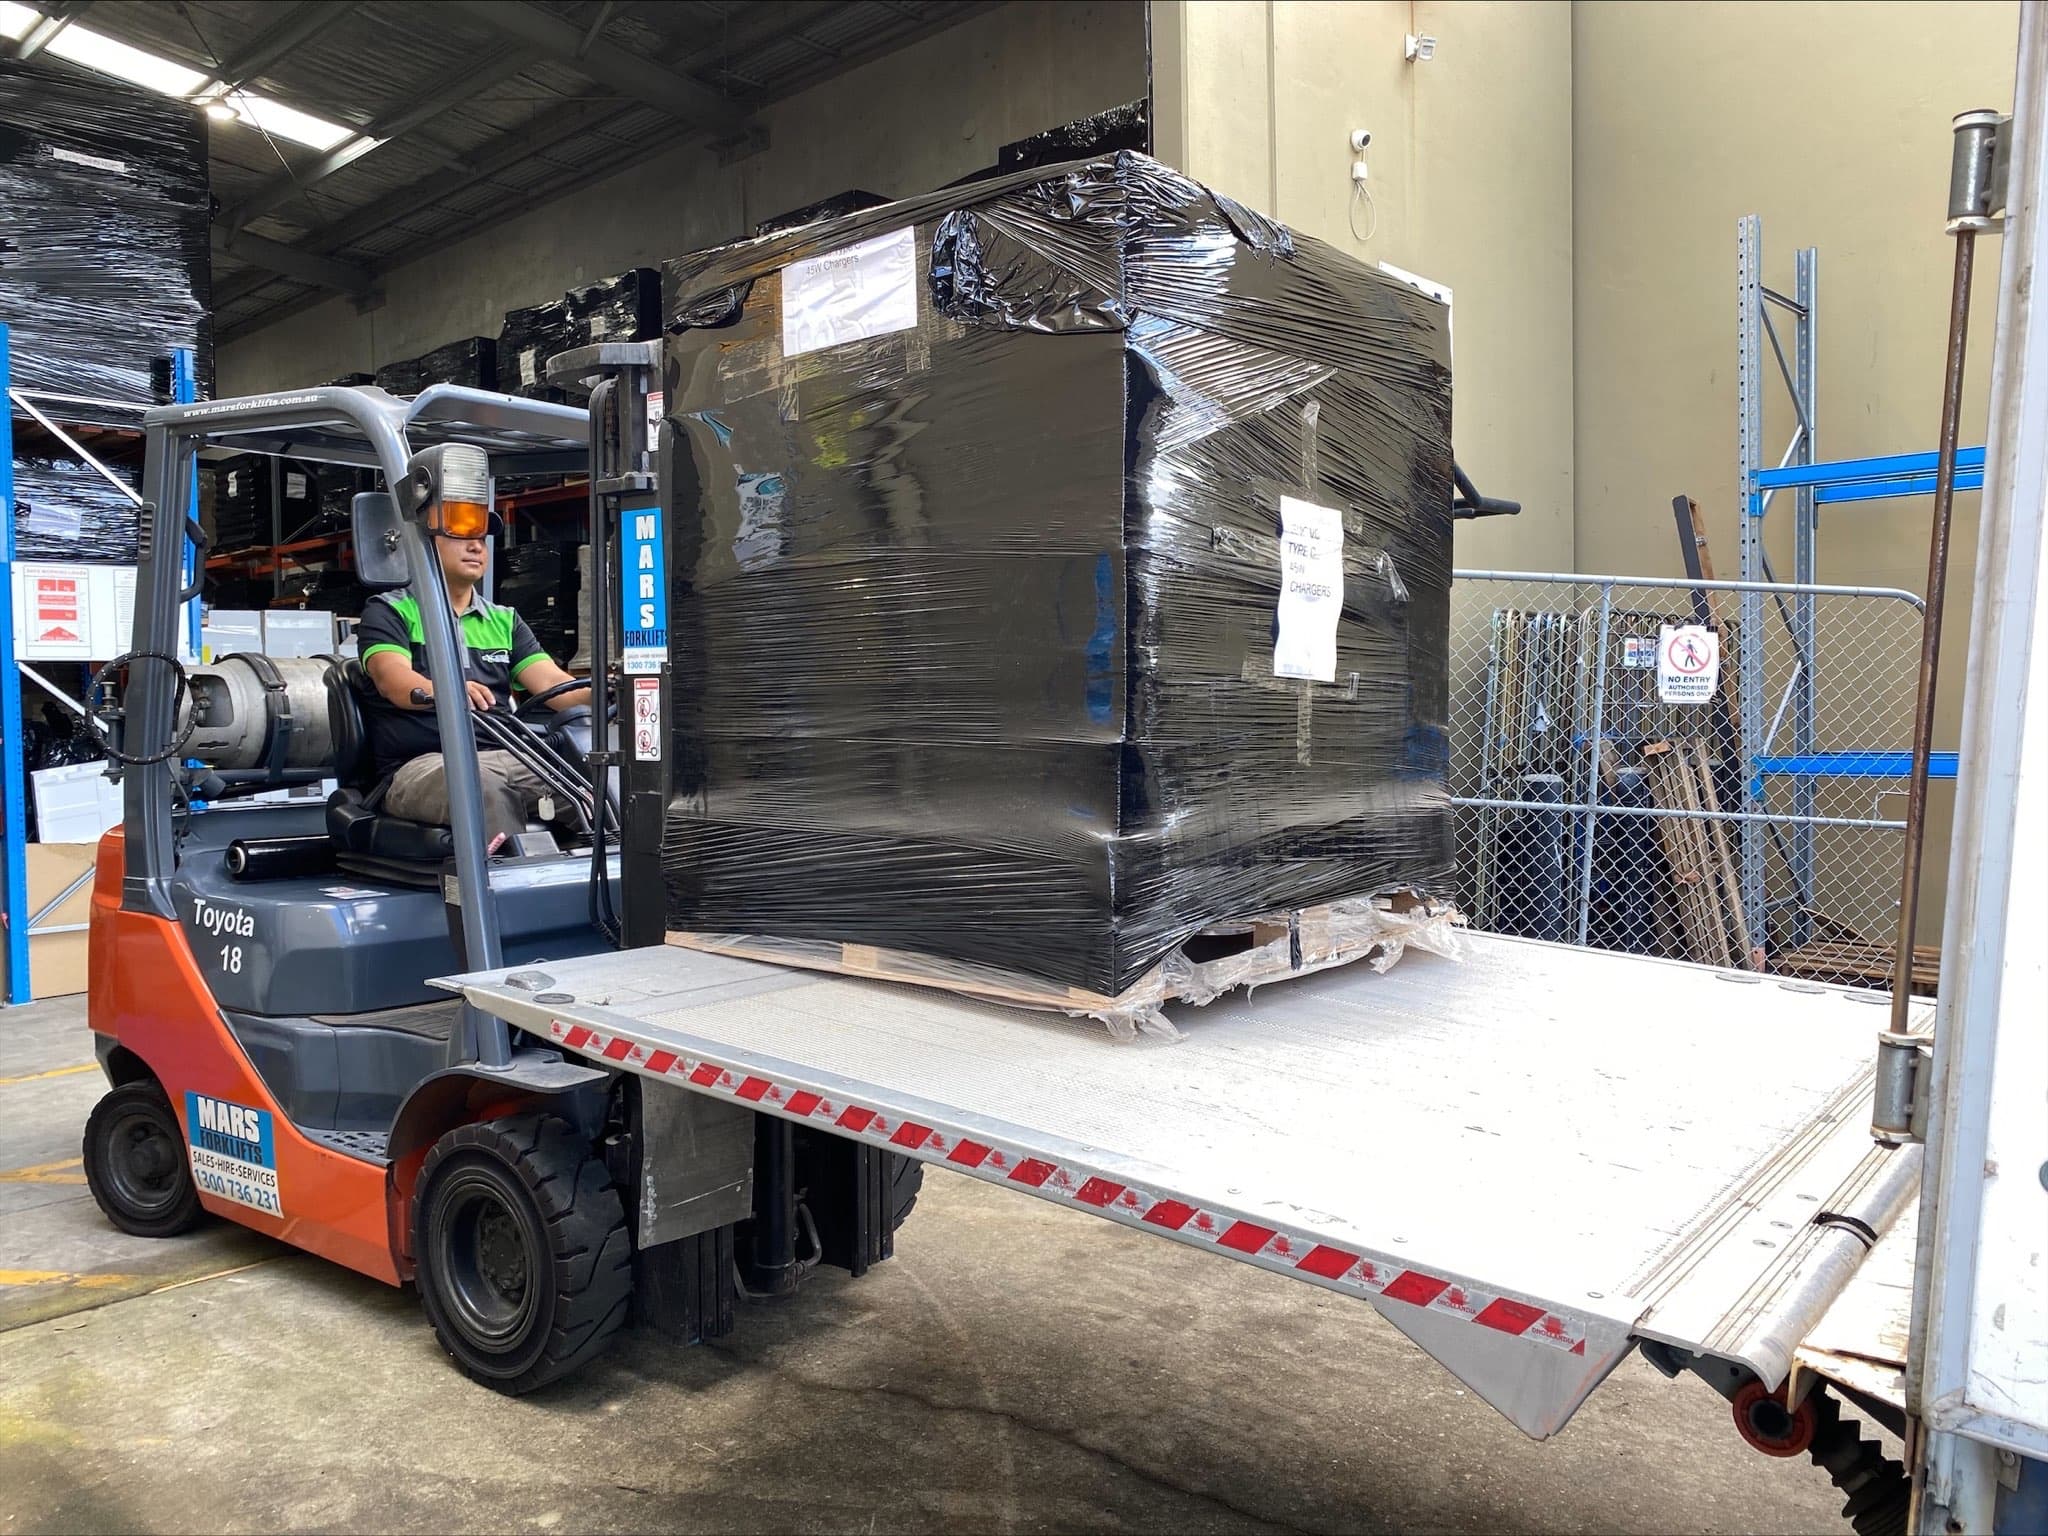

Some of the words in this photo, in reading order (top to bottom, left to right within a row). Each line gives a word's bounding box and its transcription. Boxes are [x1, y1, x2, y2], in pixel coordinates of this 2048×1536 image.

[823, 254, 859, 271] Chargers
[183, 395, 318, 417] www.marsforklifts.com.au
[1289, 541, 1308, 557] TYPE
[635, 514, 656, 629] MARS
[1290, 580, 1331, 597] CHARGERS
[194, 898, 254, 937] Toyota
[220, 945, 242, 973] 18
[197, 1096, 260, 1143] MARS
[200, 1130, 262, 1164] FORKLIFTS
[194, 1169, 225, 1193] 1300
[227, 1180, 252, 1203] 736
[254, 1188, 279, 1213] 231
[1436, 1298, 1477, 1315] DHOLLANDIA
[1532, 1327, 1575, 1344] DHOLLANDIA
